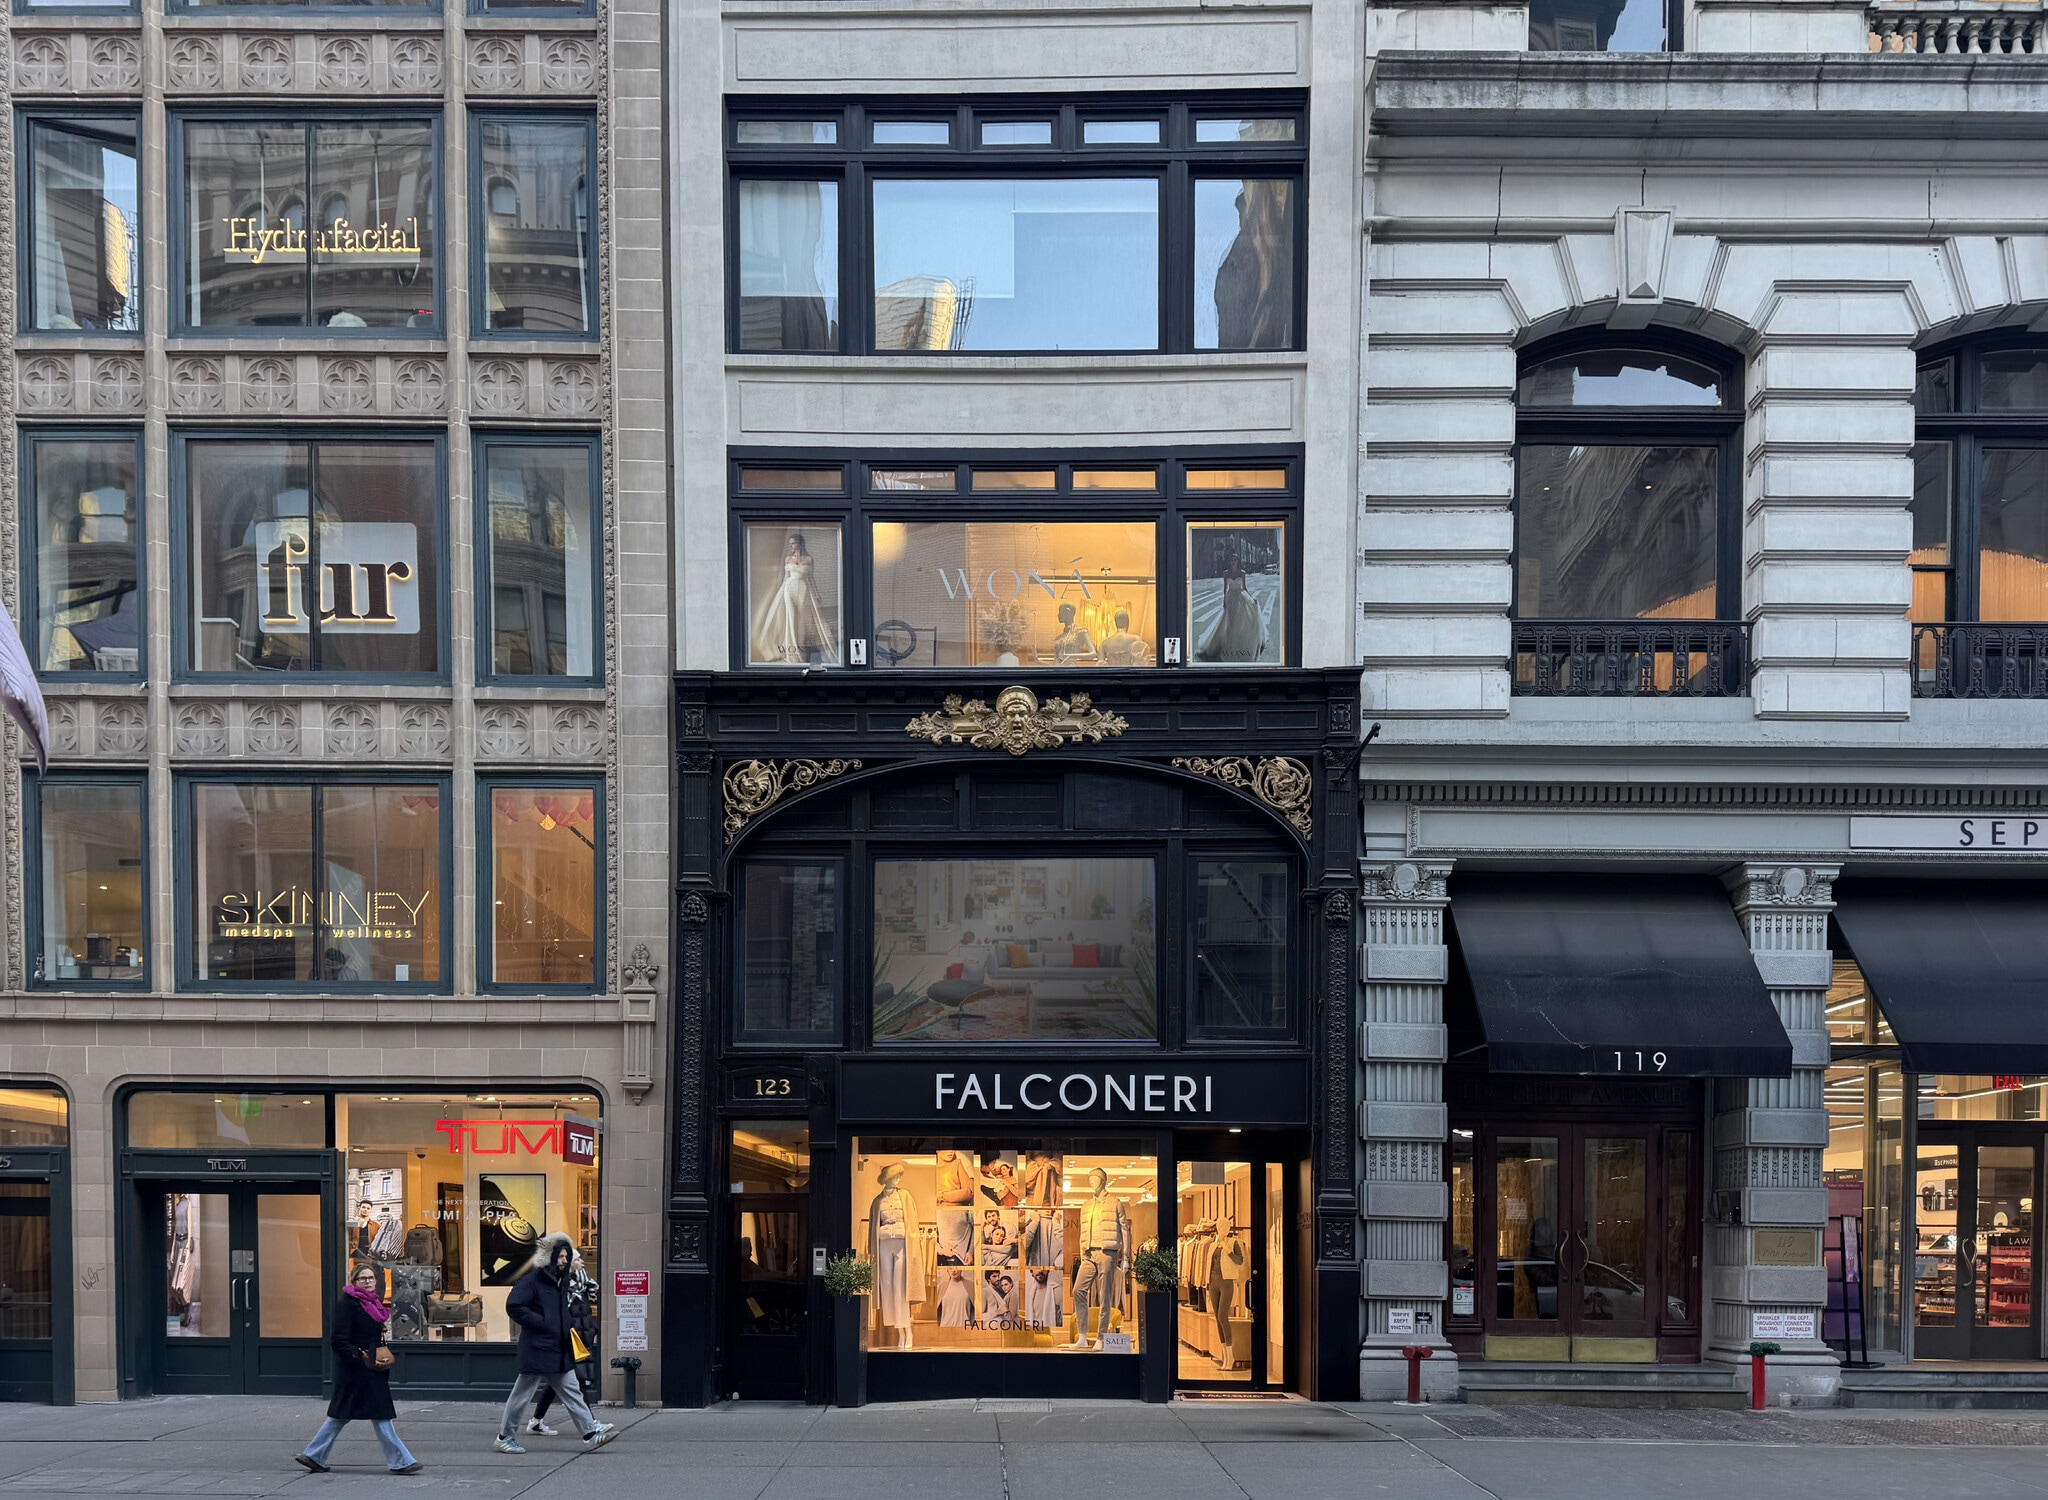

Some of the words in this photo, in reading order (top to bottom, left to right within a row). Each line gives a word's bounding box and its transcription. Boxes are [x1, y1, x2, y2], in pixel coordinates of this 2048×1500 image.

[261, 533, 412, 624] fur
[1959, 820, 2039, 846] SEP
[225, 924, 294, 939] medspa
[332, 925, 412, 938] wellness
[1614, 1051, 1667, 1071] 119
[755, 1079, 791, 1096] 123
[936, 1073, 1212, 1112] FALCONERI
[435, 1120, 564, 1155] TUMI
[207, 1159, 247, 1170] TUMI
[422, 1210, 460, 1220] TUMI
[964, 1319, 1045, 1331] FALCONERI
[1105, 1337, 1127, 1345] SALE
